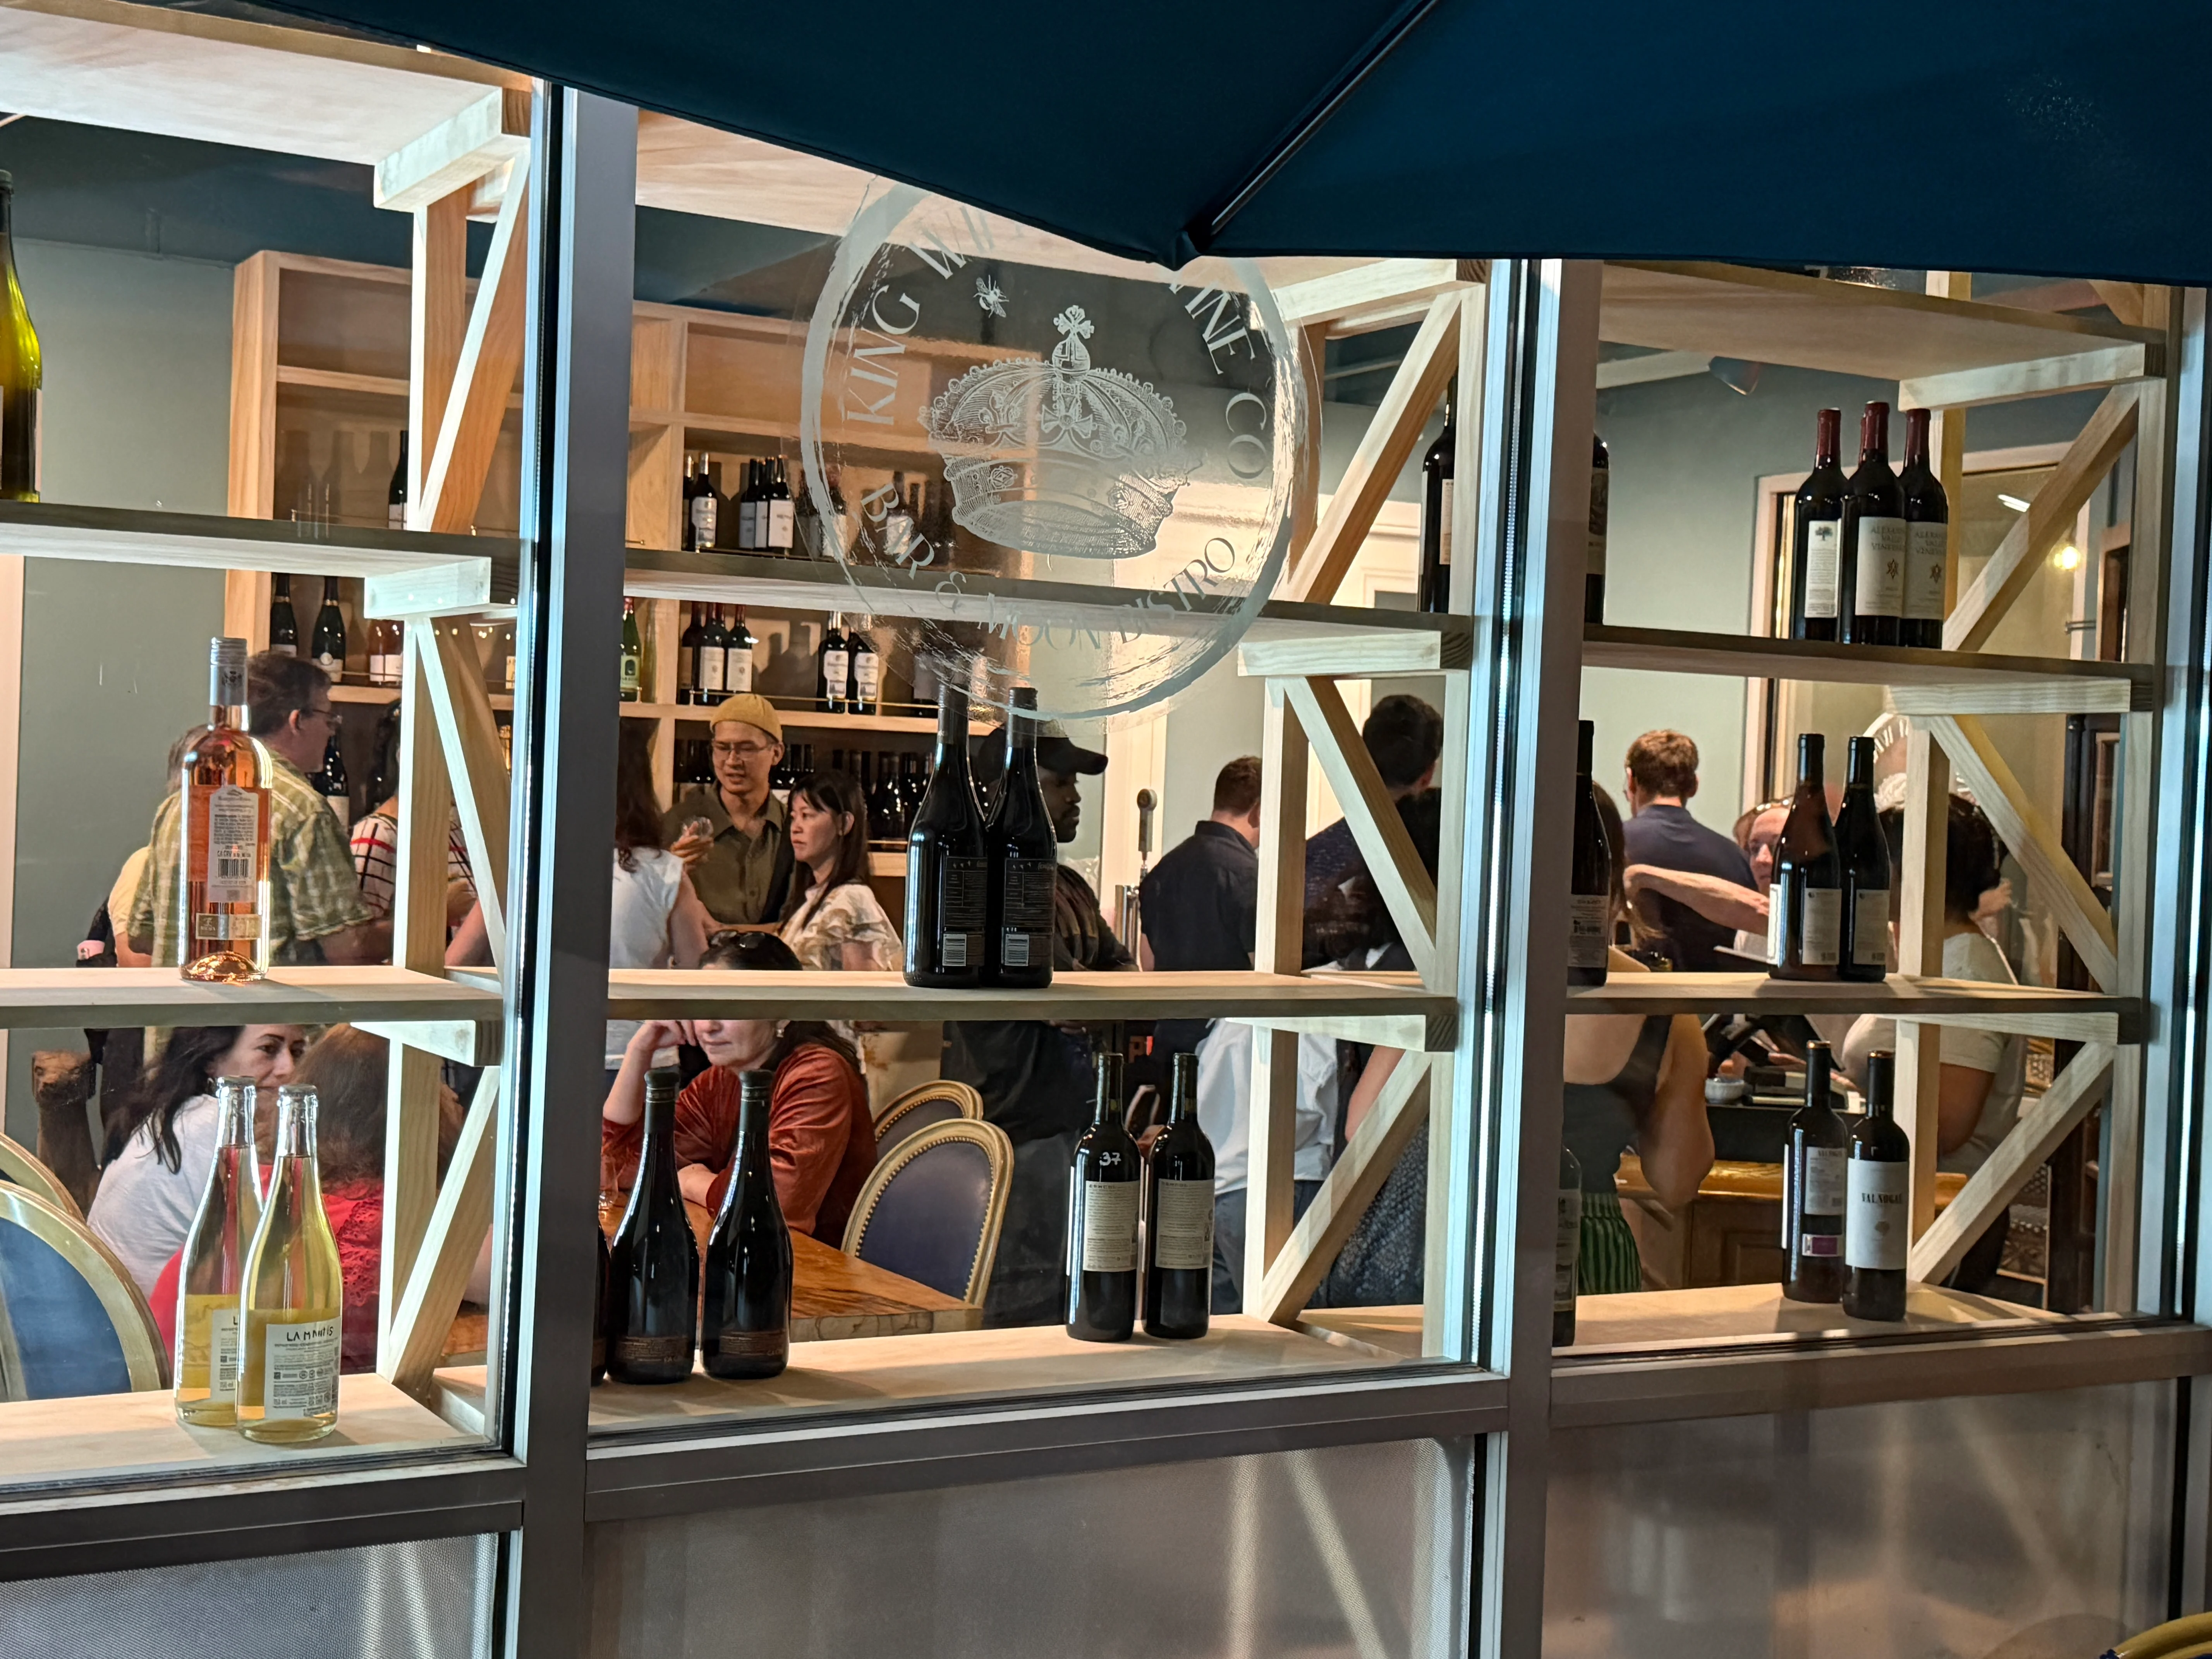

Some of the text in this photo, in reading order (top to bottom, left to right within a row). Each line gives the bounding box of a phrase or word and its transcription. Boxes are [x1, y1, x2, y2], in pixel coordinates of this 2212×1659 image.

[847, 284, 920, 425] KING
[1168, 270, 1256, 375] INE
[1226, 392, 1268, 479] CO
[861, 483, 934, 580] BAR
[935, 571, 967, 613] &
[1115, 537, 1236, 644] BISTRO
[1099, 1151, 1121, 1166] 37
[287, 1331, 301, 1342] LA
